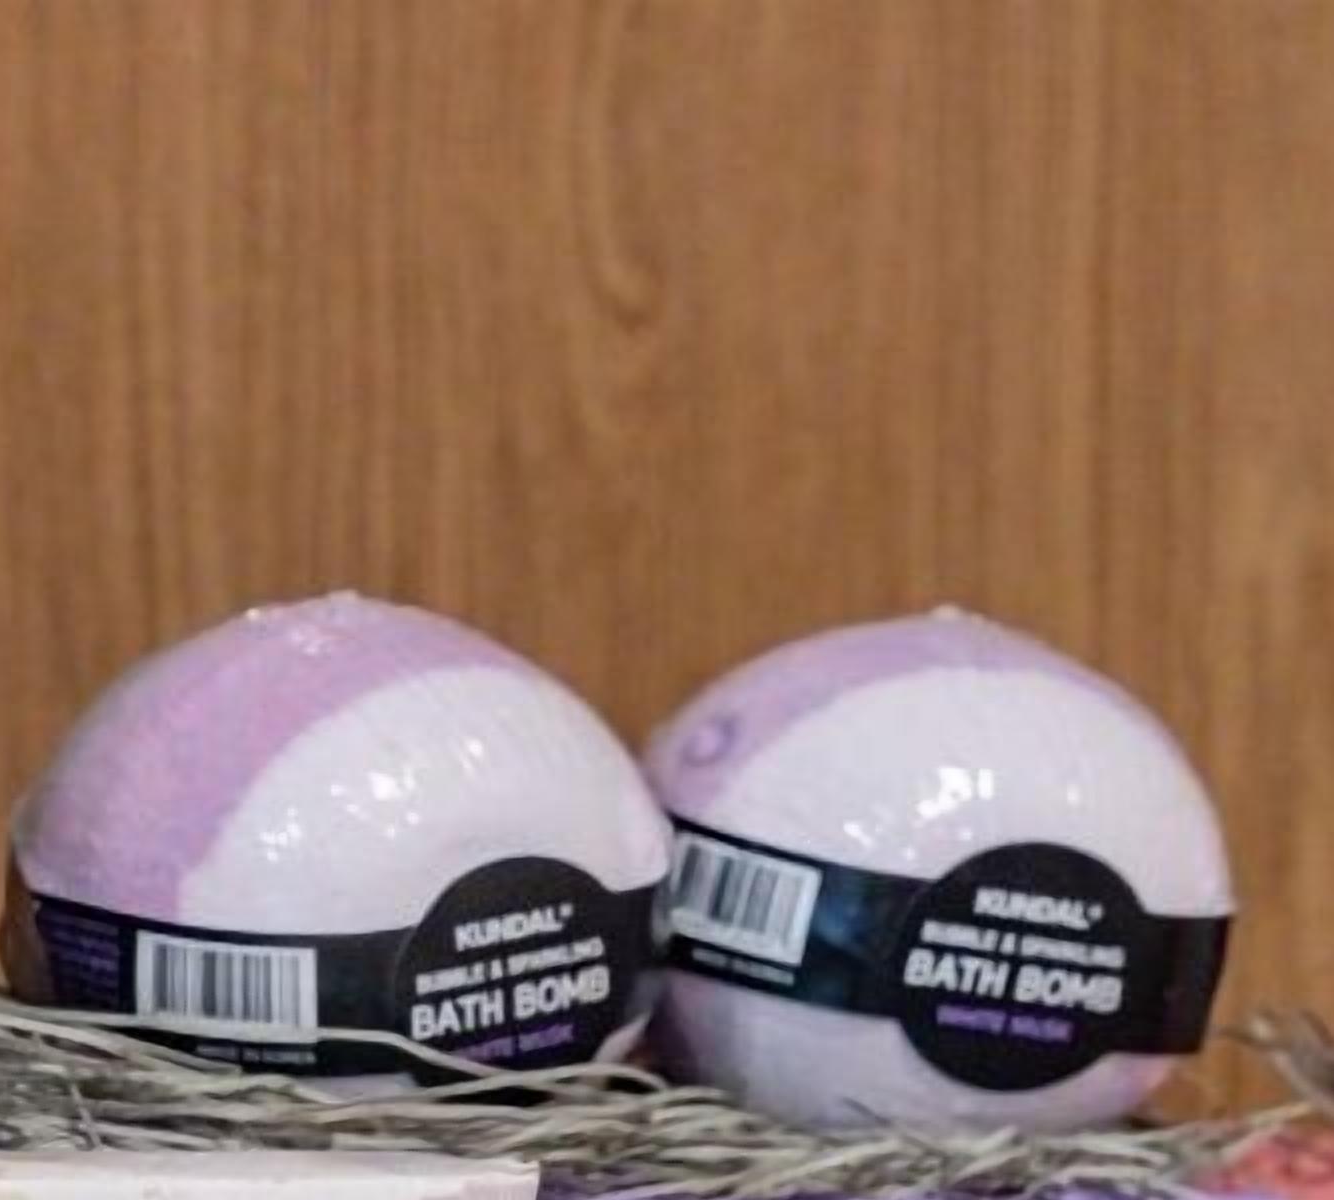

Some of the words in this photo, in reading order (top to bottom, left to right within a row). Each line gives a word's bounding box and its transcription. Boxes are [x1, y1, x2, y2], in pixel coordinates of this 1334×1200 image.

[411, 987, 505, 1041] BATH
[512, 964, 611, 1020] BOMB
[903, 948, 1010, 999] BATH
[1013, 964, 1123, 1015] BOMB
